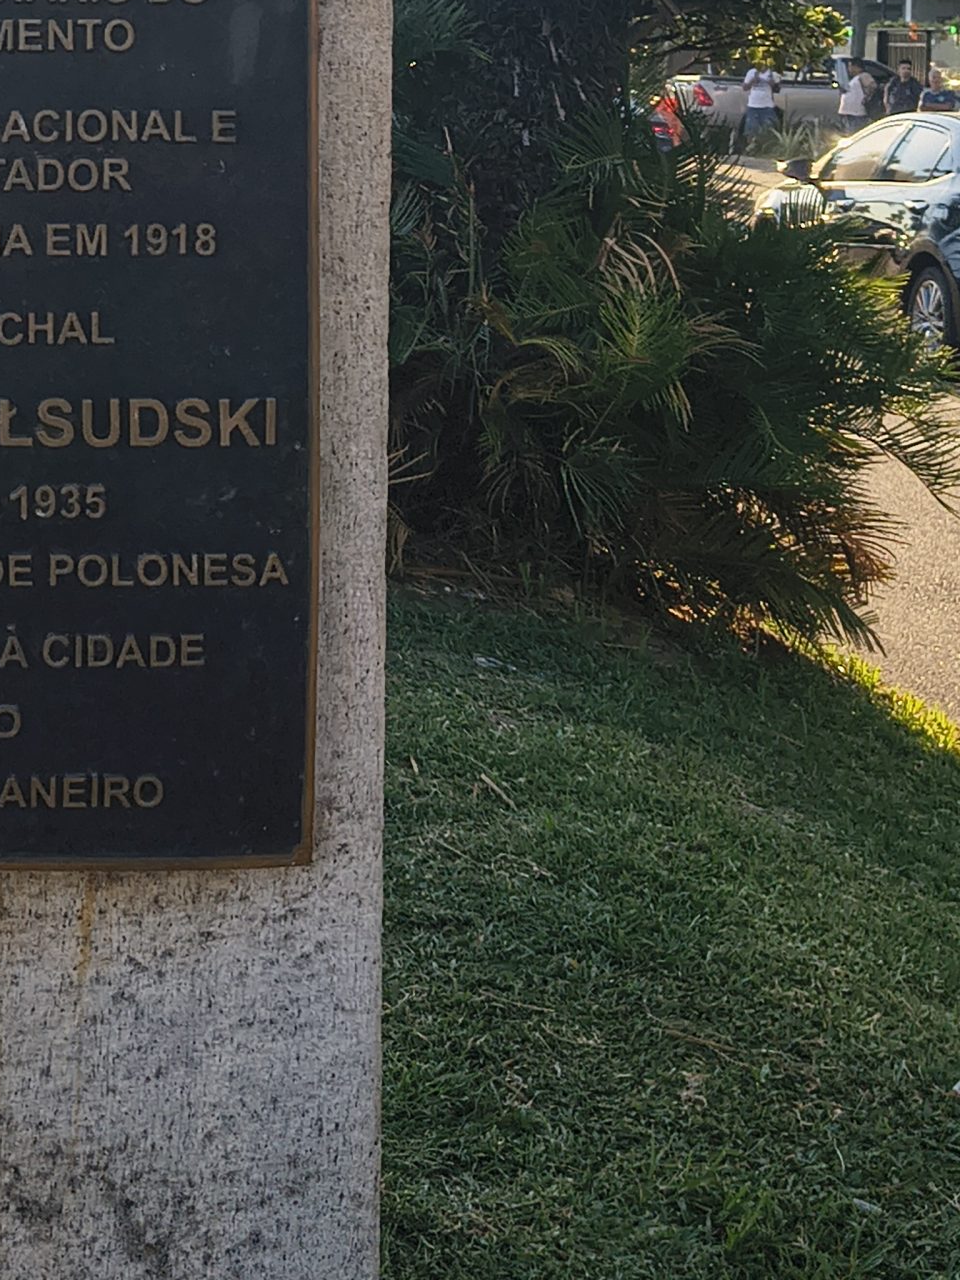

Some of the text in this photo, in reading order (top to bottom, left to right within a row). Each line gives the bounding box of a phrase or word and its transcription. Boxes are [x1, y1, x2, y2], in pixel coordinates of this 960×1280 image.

[212, 110, 237, 142] E
[46, 223, 108, 257] EM
[124, 223, 216, 257] 1918
[9, 483, 107, 520] 1935
[48, 552, 290, 588] POLONESA
[42, 632, 205, 669] CIDADE
